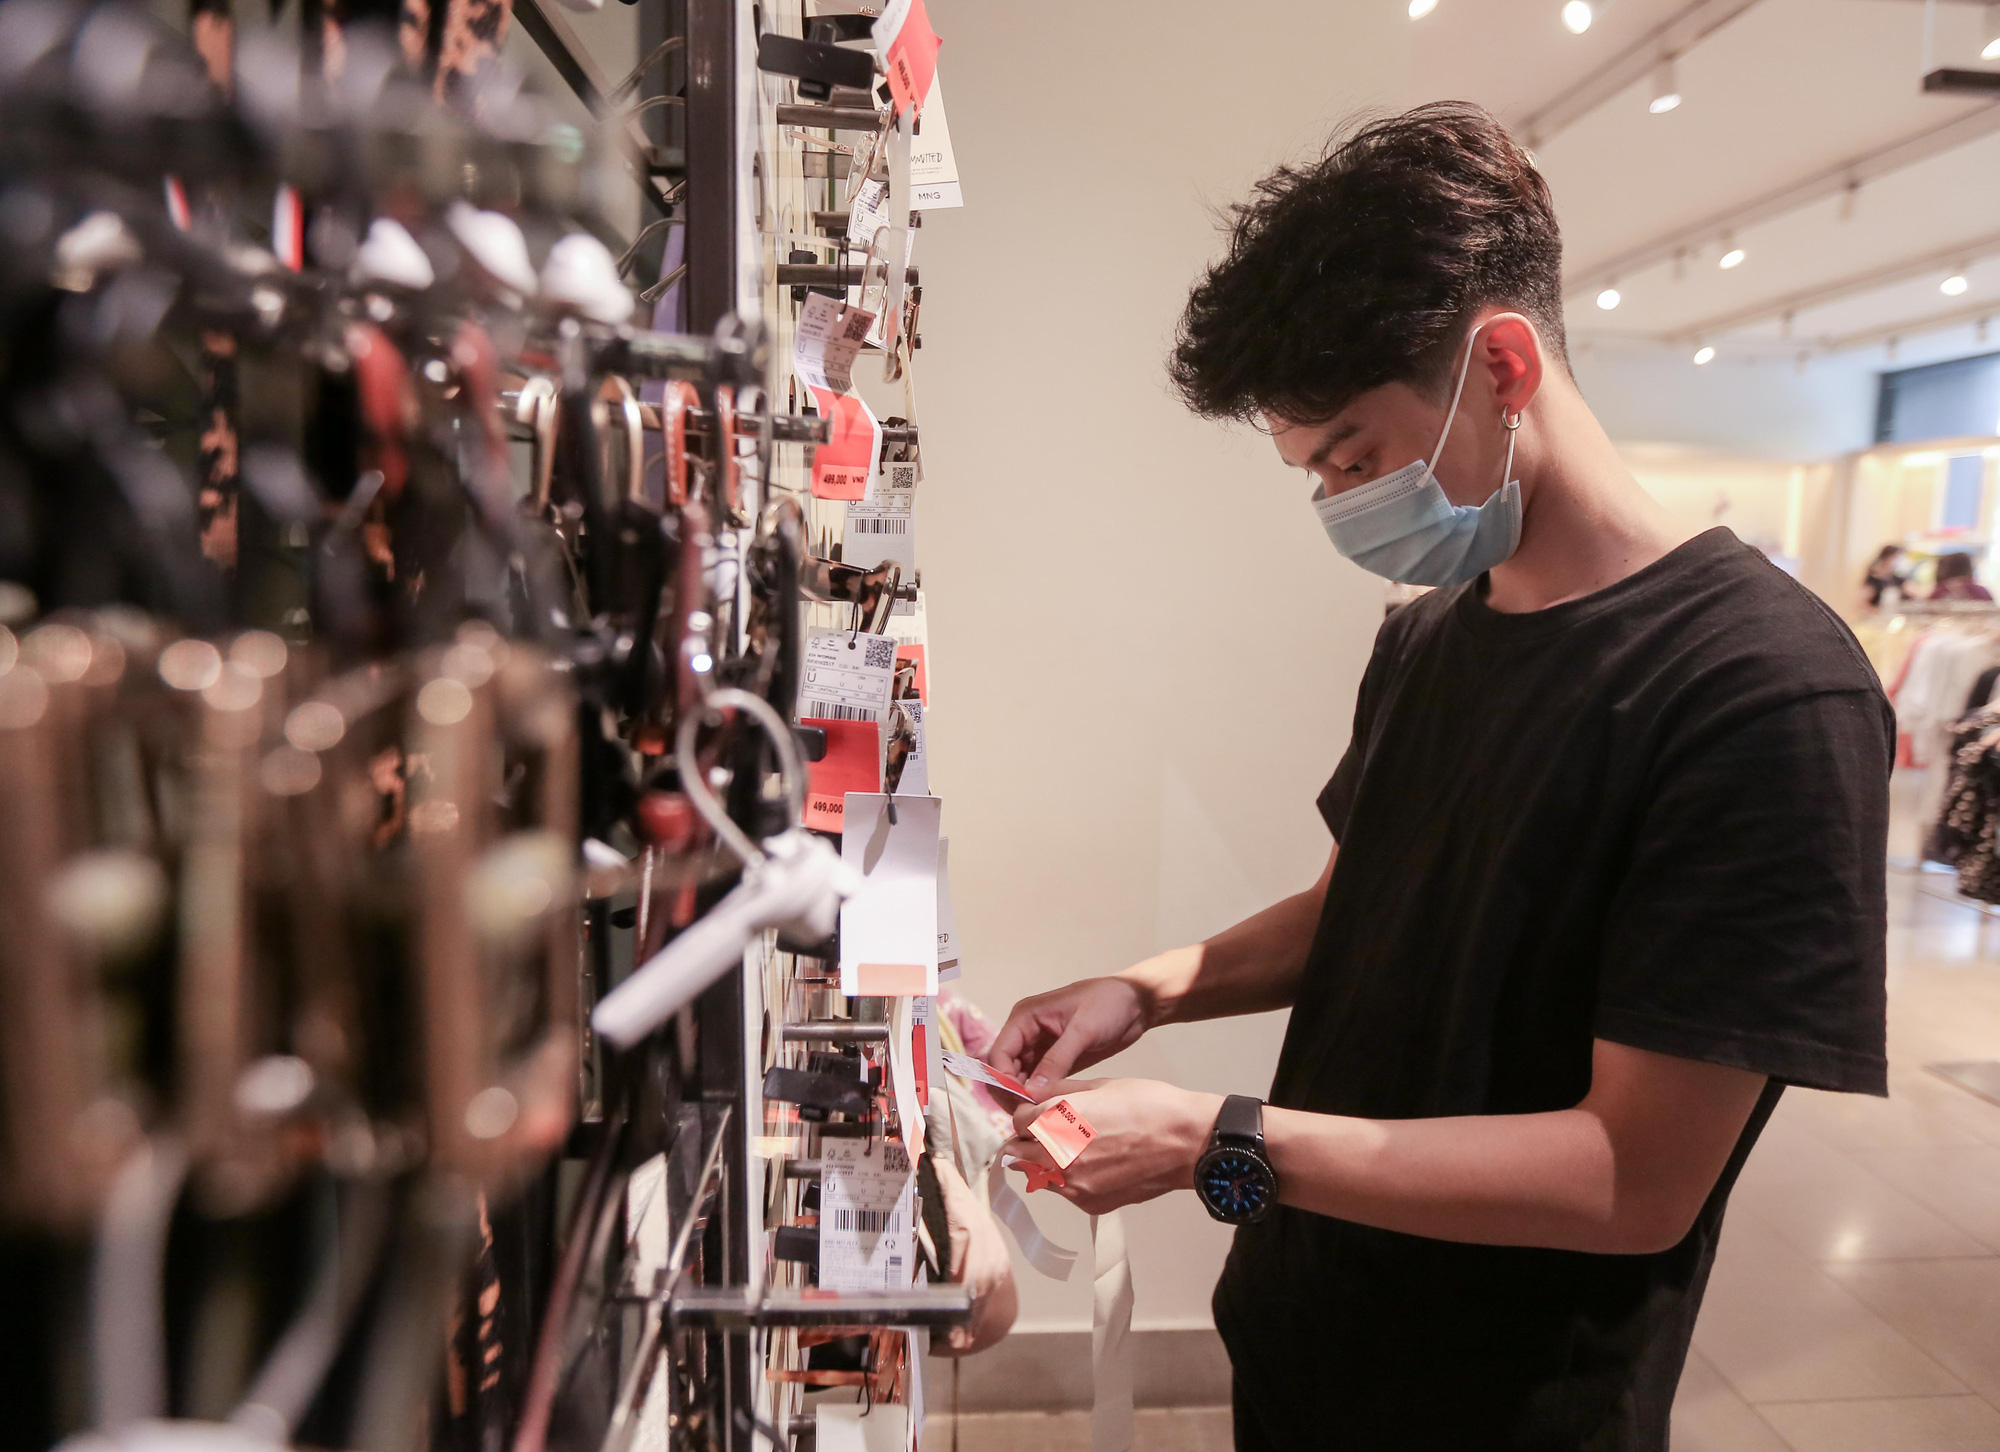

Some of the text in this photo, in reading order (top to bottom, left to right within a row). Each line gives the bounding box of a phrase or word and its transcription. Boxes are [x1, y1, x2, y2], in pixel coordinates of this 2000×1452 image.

[917, 191, 941, 200] MNG
[807, 671, 817, 683] U
[813, 801, 844, 814] 499,000
[1055, 1103, 1091, 1139] 499,000 VND
